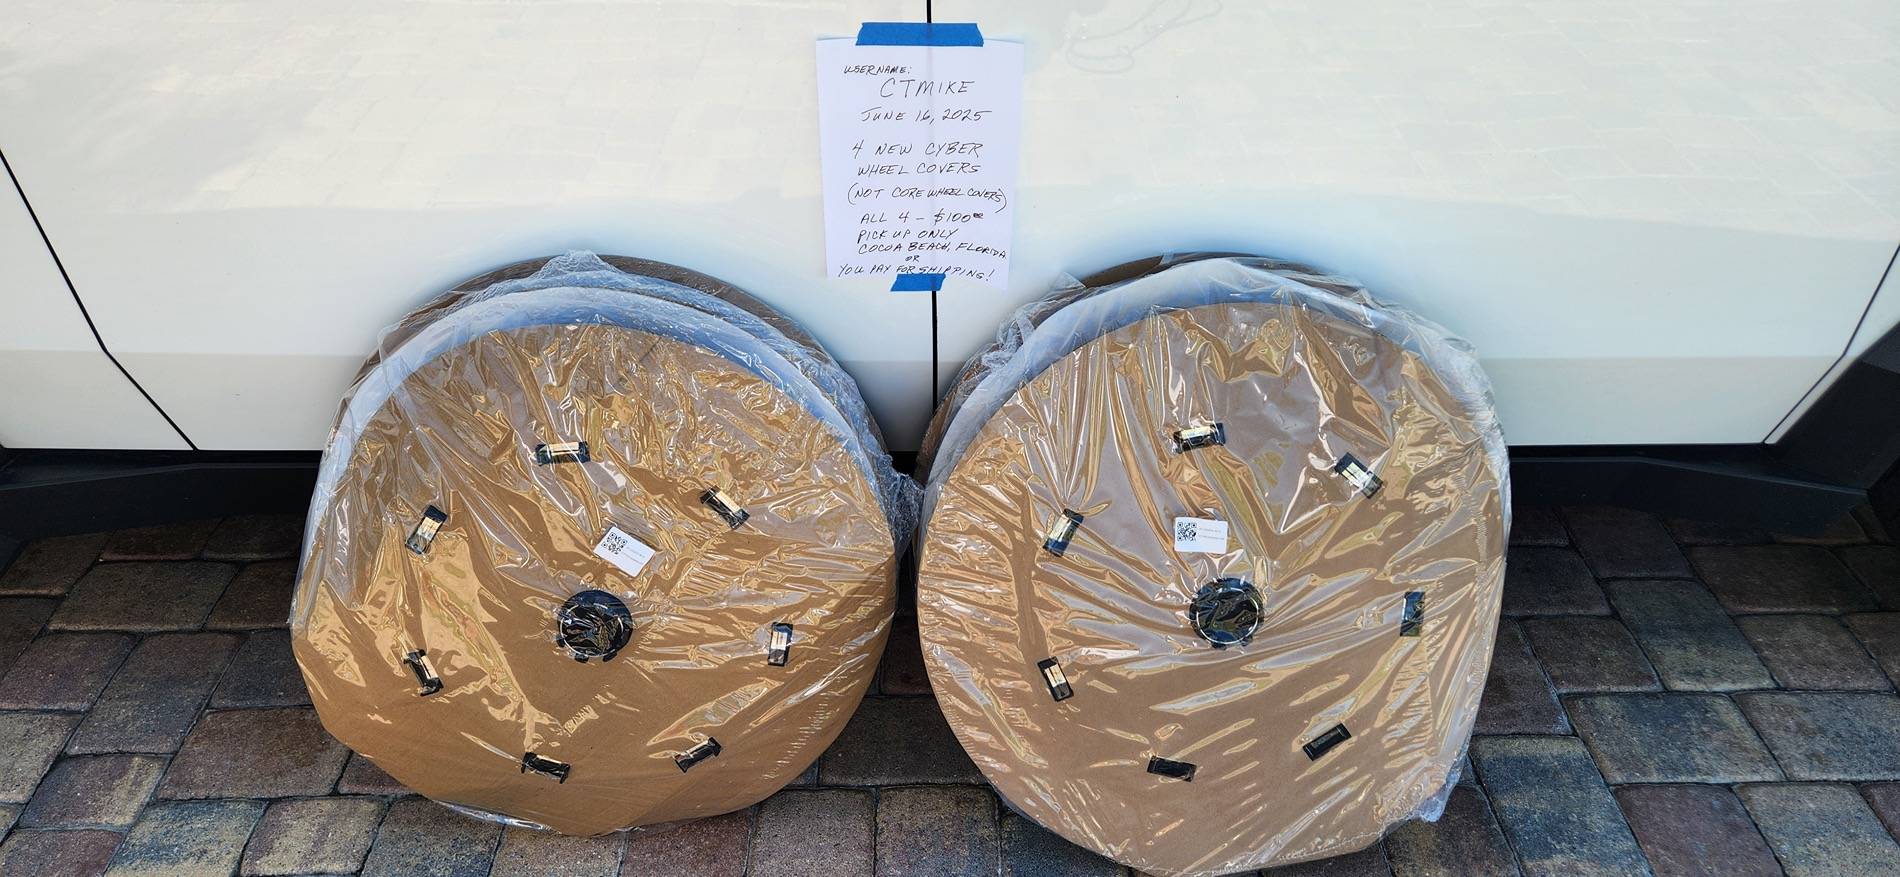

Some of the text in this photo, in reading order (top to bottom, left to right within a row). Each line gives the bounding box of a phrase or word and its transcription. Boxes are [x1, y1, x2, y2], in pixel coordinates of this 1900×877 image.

[843, 65, 911, 76] USERNAME:
[860, 106, 992, 125] JUNE 16, 2025
[852, 139, 984, 159] 4 NEW CYBER
[858, 162, 982, 177] WHEEL COVERS
[847, 182, 1007, 213] (NOT CORE WHEEL COVERS)
[860, 212, 888, 225] ALL
[898, 211, 910, 223] 4
[857, 228, 959, 245] PICK UP ONLY
[858, 241, 1007, 259] COCOA BEACH, FLORIDA
[905, 254, 921, 262] OR
[838, 262, 995, 282] YOU PAY FOR SHIPPING!
